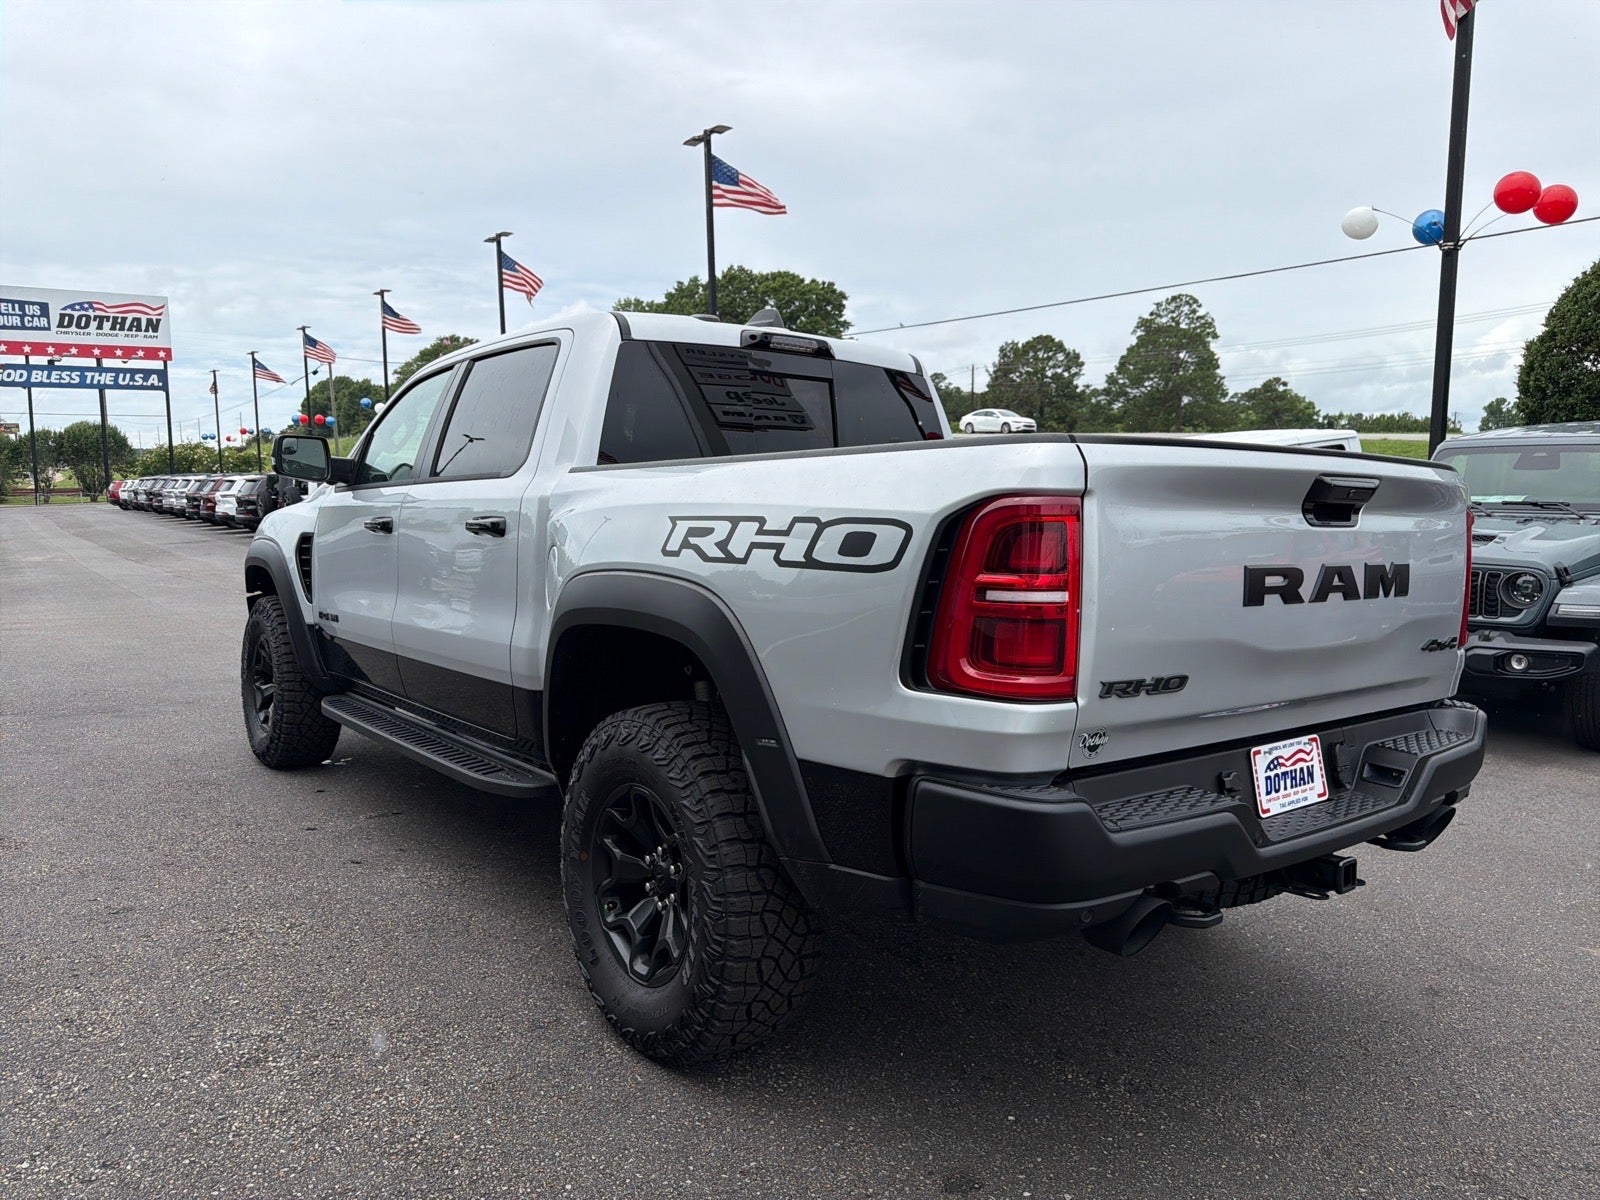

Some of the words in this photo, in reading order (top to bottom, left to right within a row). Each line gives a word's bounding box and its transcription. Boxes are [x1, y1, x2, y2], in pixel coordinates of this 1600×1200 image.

[0, 303, 22, 314] ELL
[25, 304, 41, 316] US
[24, 316, 49, 327] CAR
[57, 313, 161, 333] DOTHAN
[0, 369, 28, 382] OD
[30, 370, 80, 384] BLESS
[84, 372, 115, 385] THE
[118, 373, 163, 386] U.S.A.
[661, 516, 913, 573] RHO
[1242, 561, 1410, 607] RAM
[1098, 674, 1189, 699] RHO
[1265, 764, 1315, 797] DOTHAN
